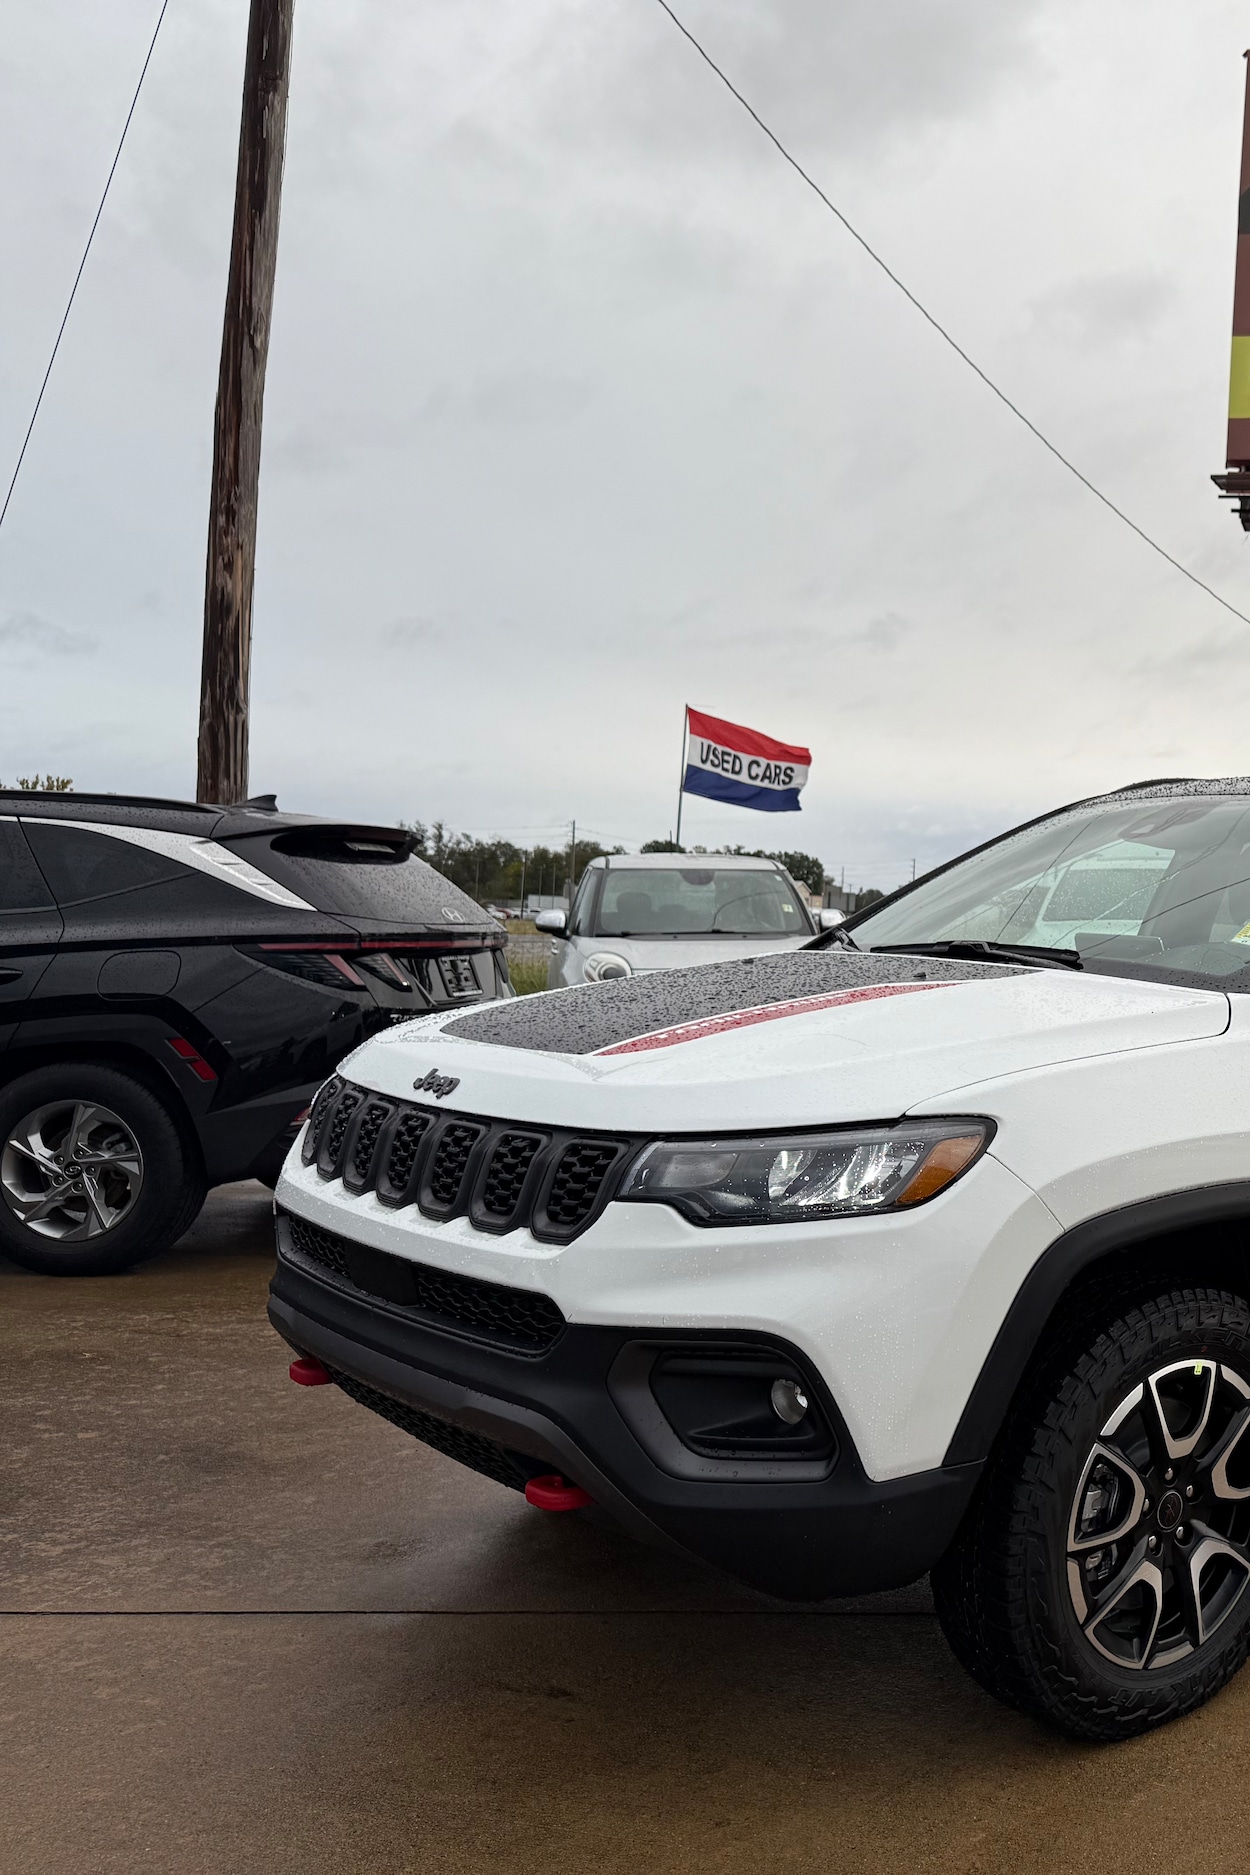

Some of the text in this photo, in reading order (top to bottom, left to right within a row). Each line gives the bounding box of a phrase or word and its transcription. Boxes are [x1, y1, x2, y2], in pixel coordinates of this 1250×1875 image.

[700, 741, 795, 786] USED CARS
[413, 1068, 461, 1100] Jeep
